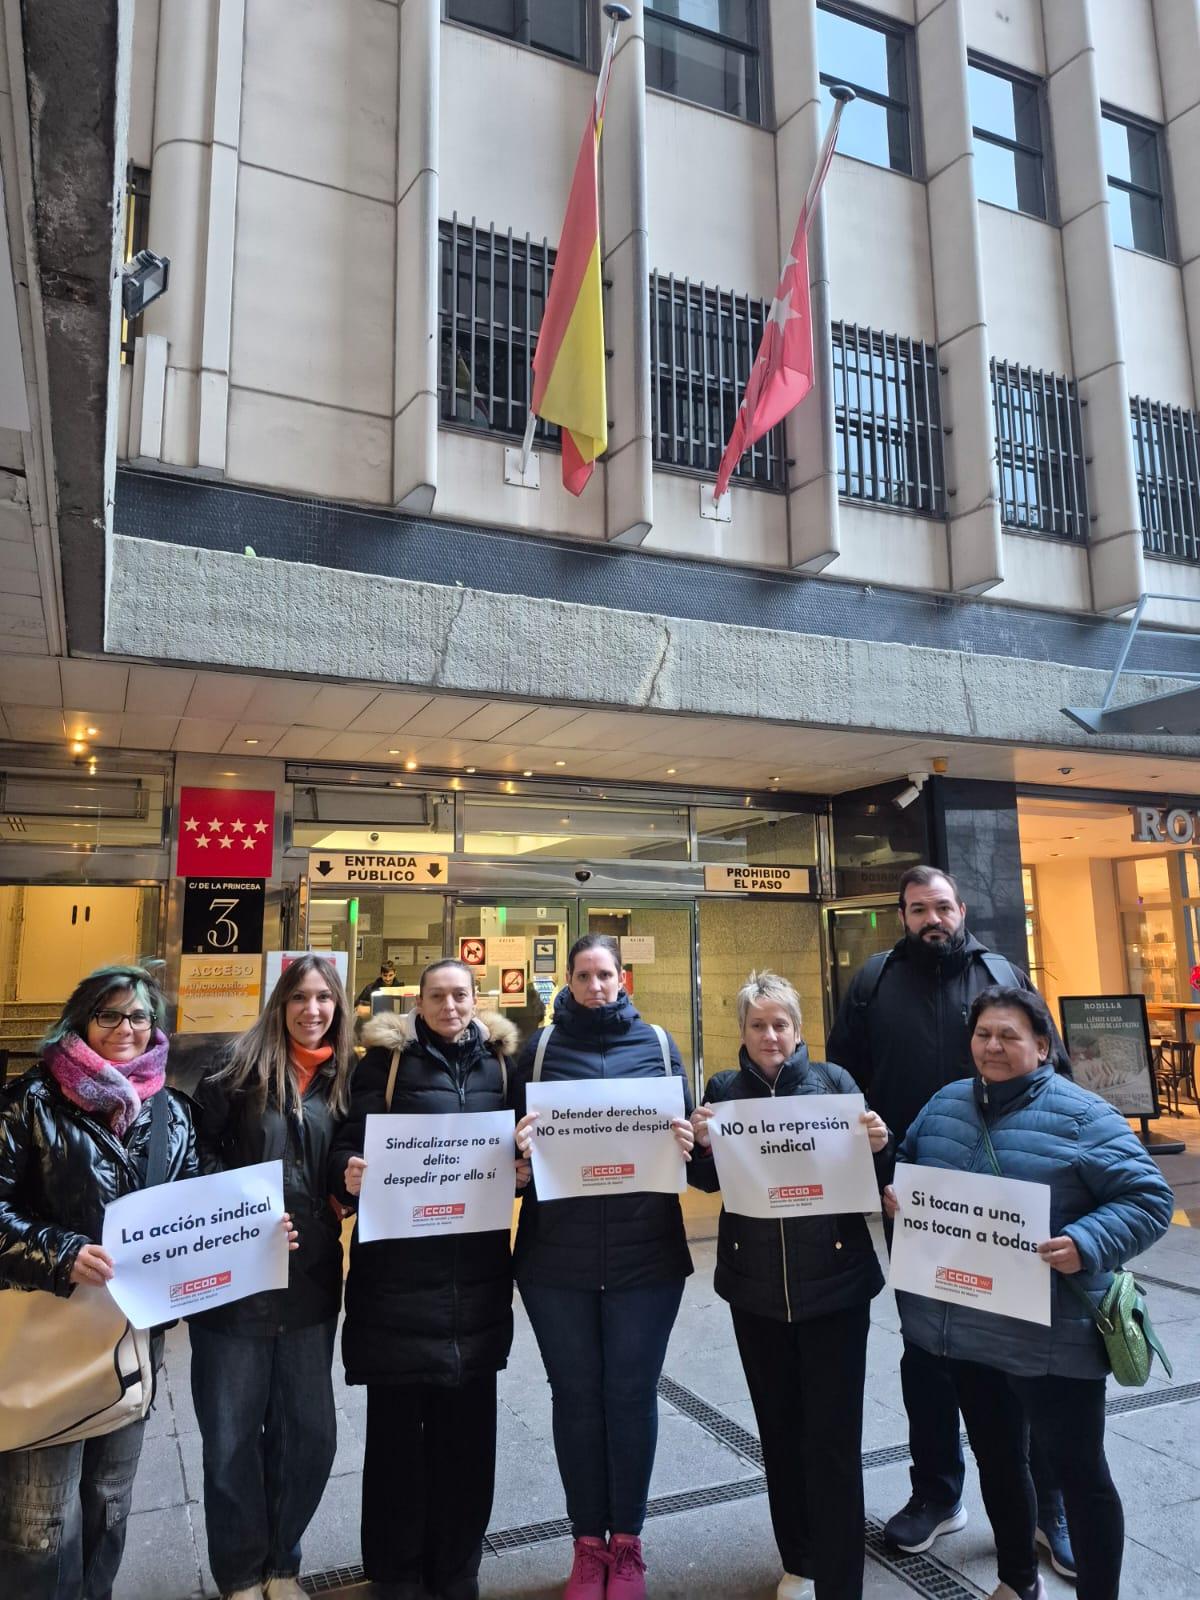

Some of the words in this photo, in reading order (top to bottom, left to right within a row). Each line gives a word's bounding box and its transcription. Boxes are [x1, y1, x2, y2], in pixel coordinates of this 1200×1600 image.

[1131, 806, 1200, 844] RO
[345, 856, 416, 867] ENTRADA
[348, 868, 414, 881] PÚBLICO
[727, 868, 790, 879] PROHIBIDO
[734, 879, 748, 888] EL
[752, 880, 782, 889] PASO
[208, 898, 240, 947] 3
[192, 966, 254, 976] ACCESO
[552, 1109, 604, 1120] Defender
[606, 1106, 657, 1116] derechos
[537, 1126, 554, 1136] NO
[558, 1127, 570, 1136] es
[573, 1124, 612, 1135] motivo
[616, 1121, 629, 1132] de
[721, 1122, 744, 1136] NO
[748, 1125, 757, 1134] a
[762, 1120, 774, 1133] la
[780, 1117, 849, 1134] represión
[386, 1137, 468, 1150] Sindicalizarse
[472, 1138, 486, 1146] no
[488, 1137, 500, 1145] es
[760, 1137, 815, 1154] sindical
[423, 1154, 460, 1166] delito:
[384, 1170, 437, 1187] despedir
[440, 1173, 461, 1185] por
[464, 1169, 484, 1180] ello
[487, 1168, 496, 1179] sí
[594, 1166, 621, 1175] CCOO
[782, 1187, 809, 1196] CCOO
[426, 1206, 452, 1215] CCOO
[912, 1191, 925, 1206] Si
[930, 1195, 968, 1214] tocan
[973, 1206, 983, 1216] a
[989, 1209, 1026, 1227] una,
[121, 1228, 144, 1244] La
[150, 1214, 206, 1238] acción
[210, 1196, 272, 1224] sindical
[904, 1217, 928, 1230] nos
[932, 1220, 971, 1239] tocan
[976, 1232, 986, 1243] a
[992, 1231, 1038, 1253] todas
[142, 1250, 161, 1264] es
[166, 1245, 188, 1259] un
[193, 1226, 260, 1251] derecho
[185, 1277, 216, 1292] CCOO
[949, 1272, 977, 1285] CCOO
